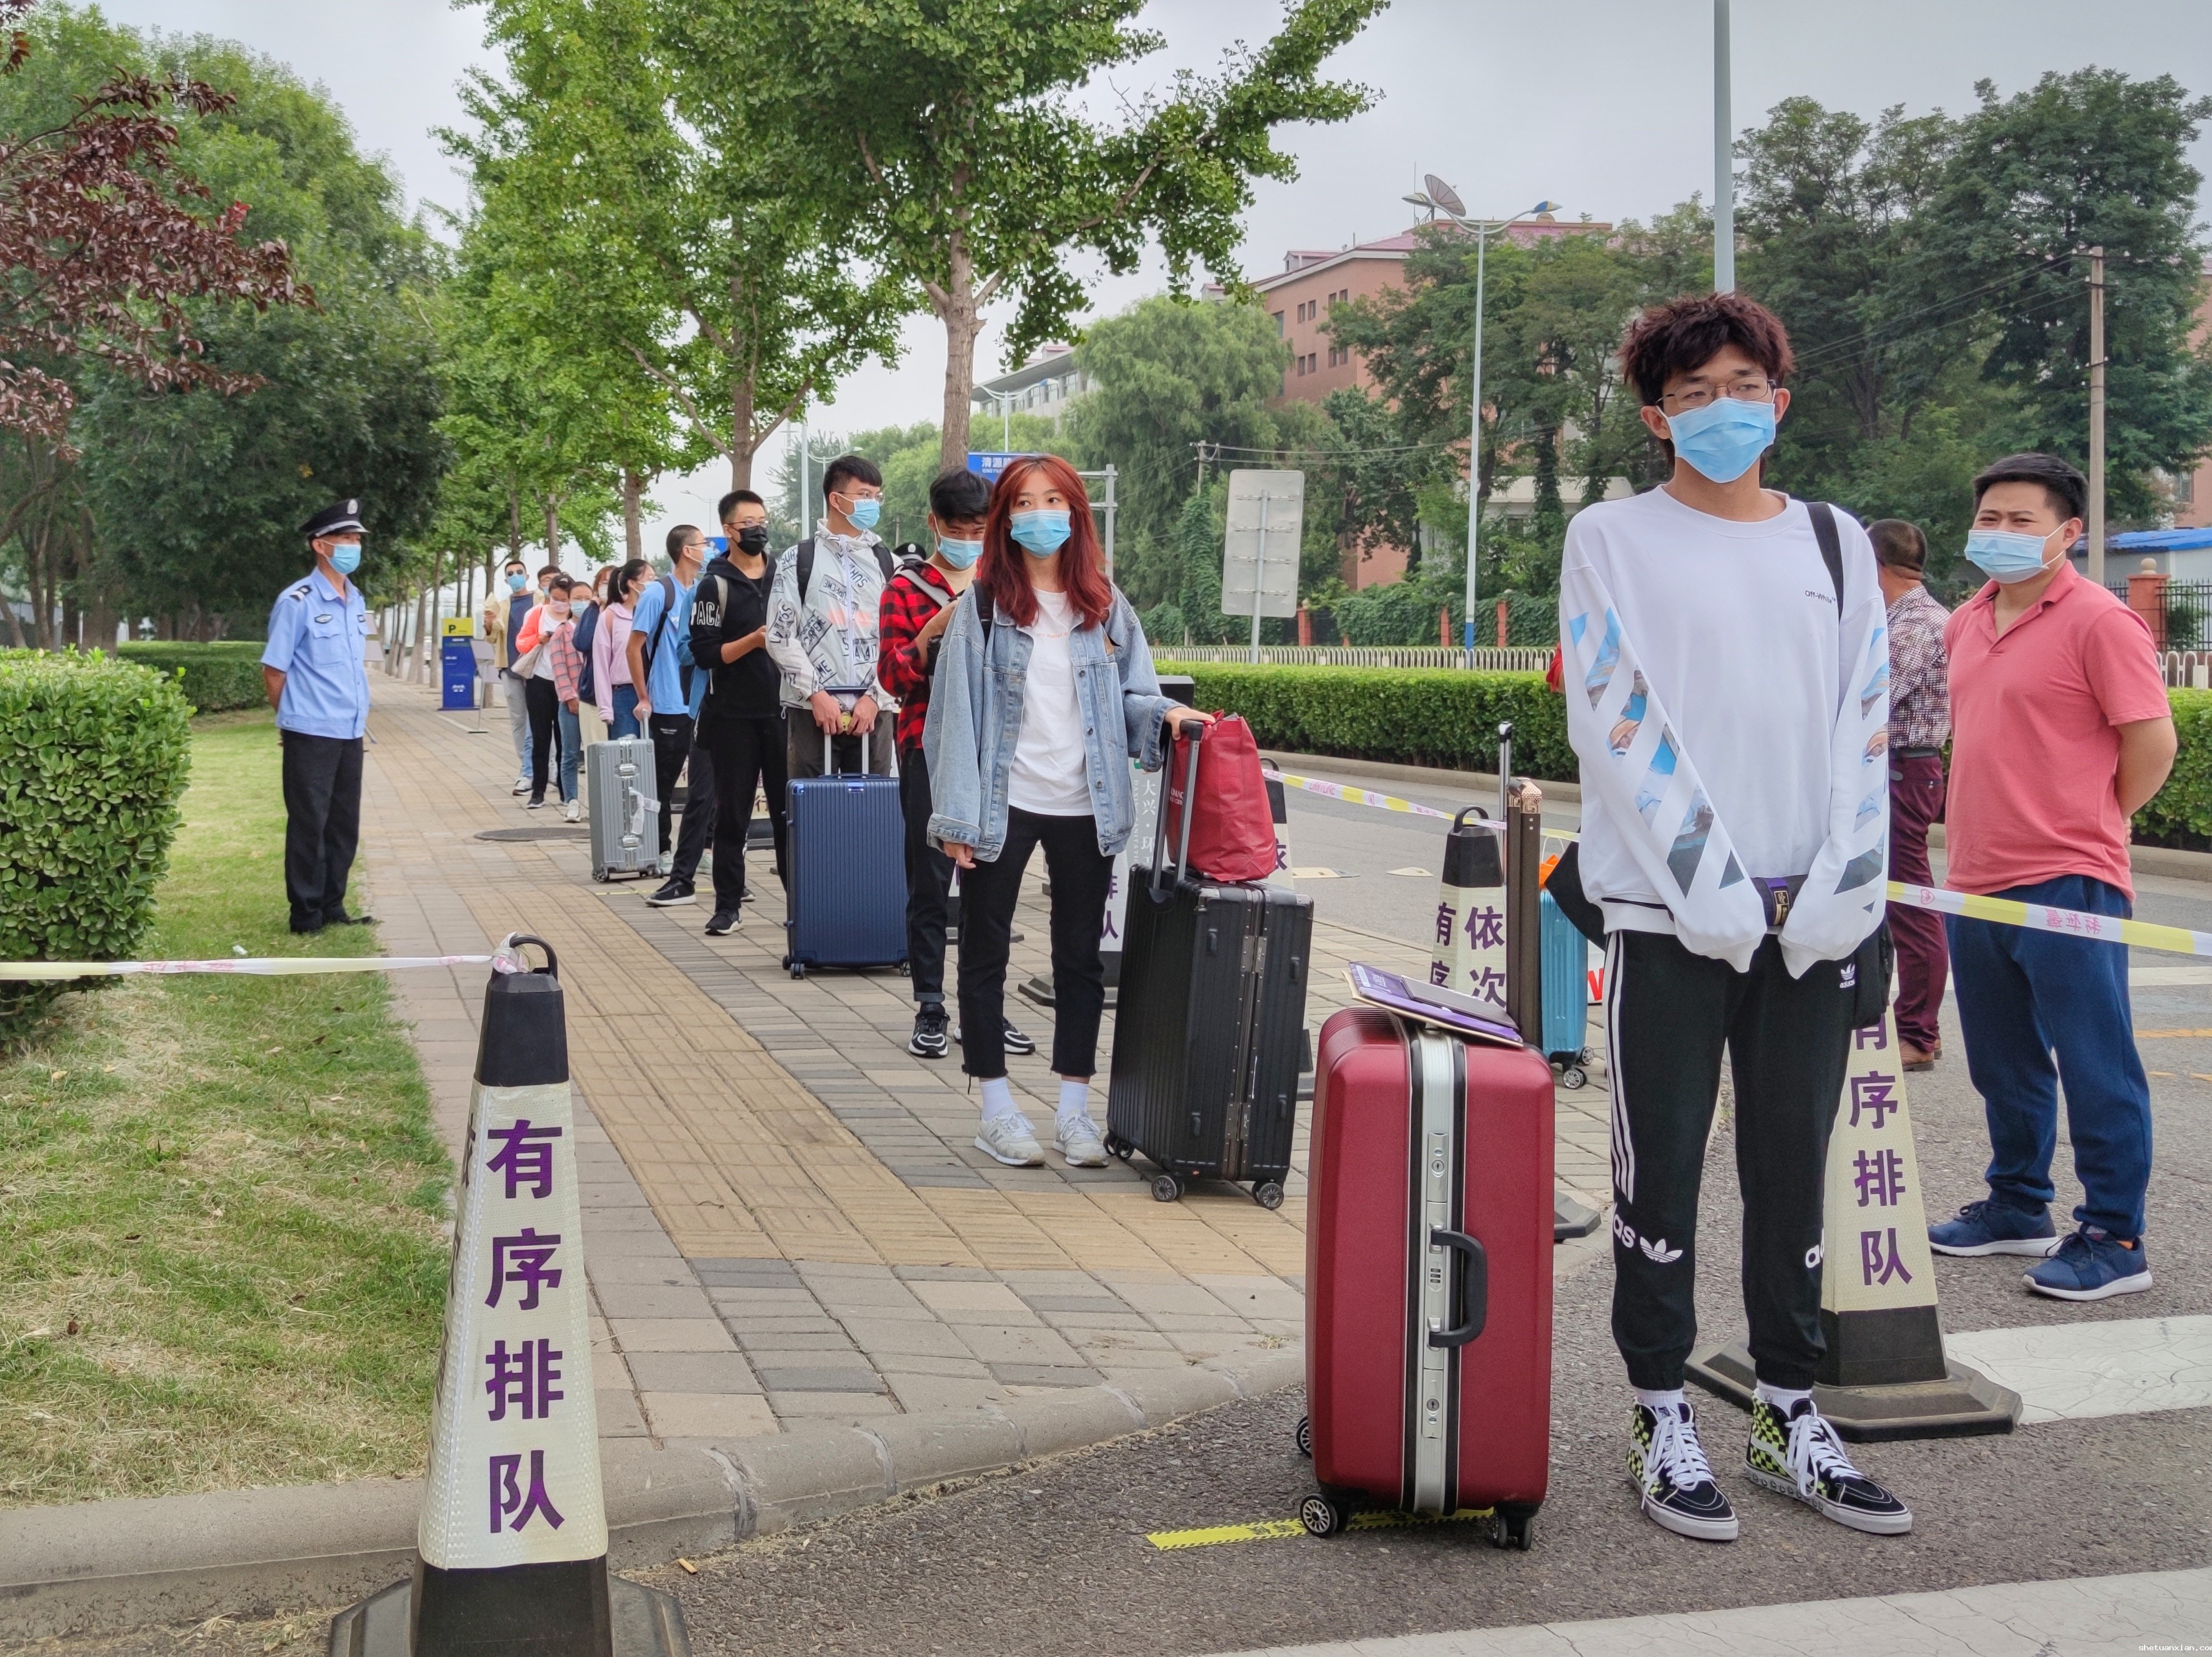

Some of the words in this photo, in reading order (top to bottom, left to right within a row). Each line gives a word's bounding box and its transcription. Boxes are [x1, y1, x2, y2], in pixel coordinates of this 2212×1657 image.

[449, 625, 455, 633] P
[1464, 905, 1507, 1009] 依次
[485, 1119, 565, 1533] 有序排队
